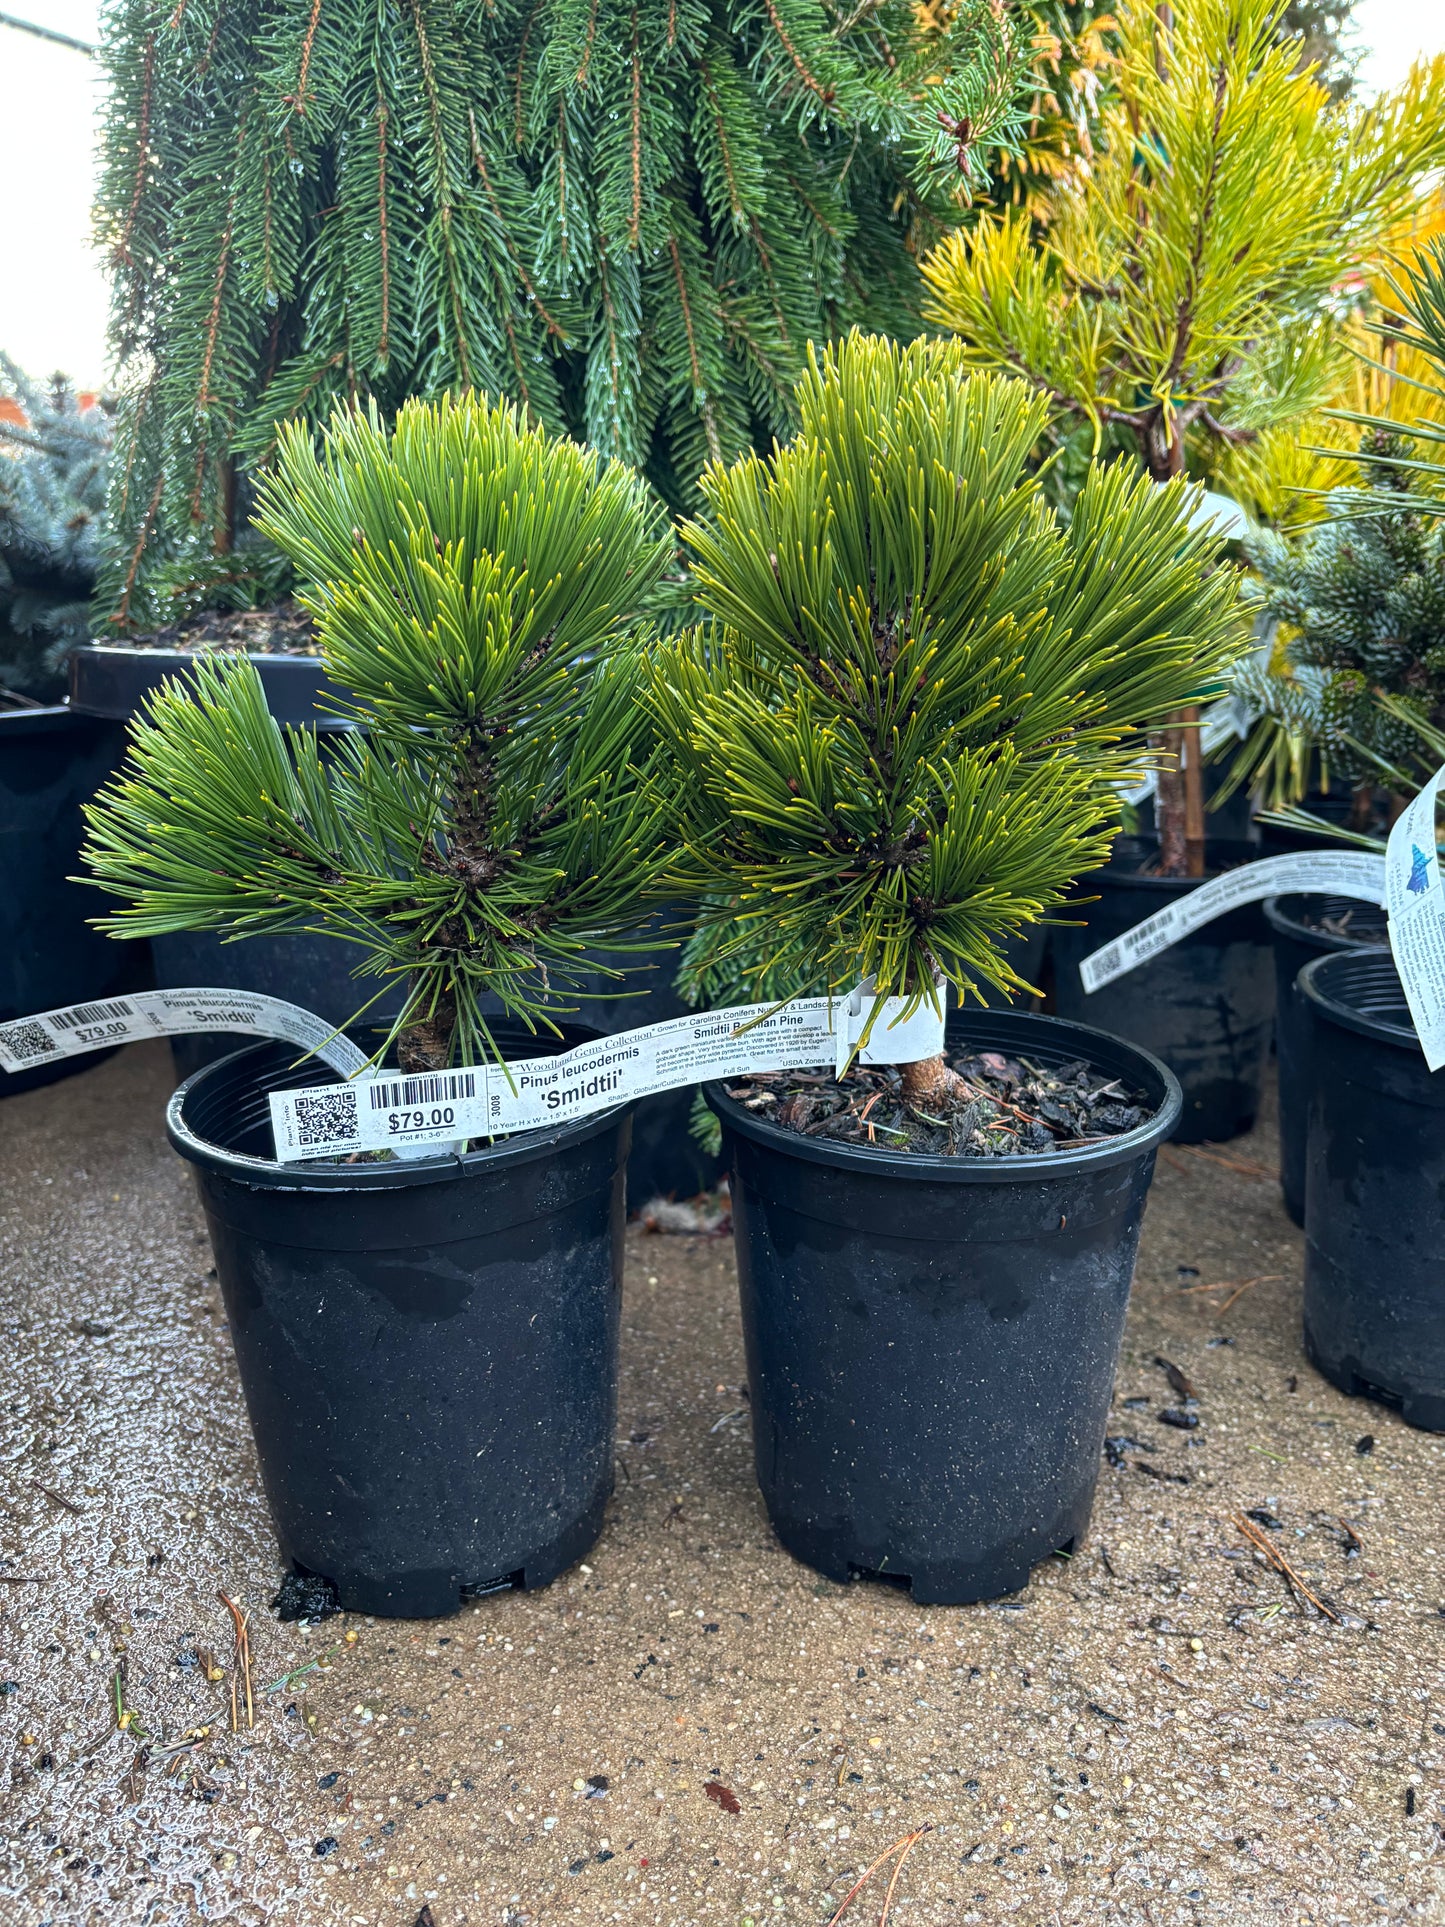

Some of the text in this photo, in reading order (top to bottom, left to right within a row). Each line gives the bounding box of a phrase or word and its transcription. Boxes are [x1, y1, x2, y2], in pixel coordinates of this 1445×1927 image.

[163, 1000, 196, 1008] Pinus
[76, 1022, 127, 1041] $79.00
[574, 1045, 602, 1058] Gems
[657, 1024, 678, 1032] Grown
[690, 1014, 722, 1026] Carolina
[723, 1008, 756, 1020] Conifers
[694, 1024, 730, 1039] Smidtii
[780, 1016, 804, 1026] Pine
[520, 1047, 640, 1088] Pinus leucodermis
[542, 1068, 624, 1110] 'Smidtii'
[490, 1095, 500, 1117] 3008
[388, 1107, 454, 1132] $79.00
[500, 1120, 518, 1129] Year
[532, 1114, 542, 1124] W
